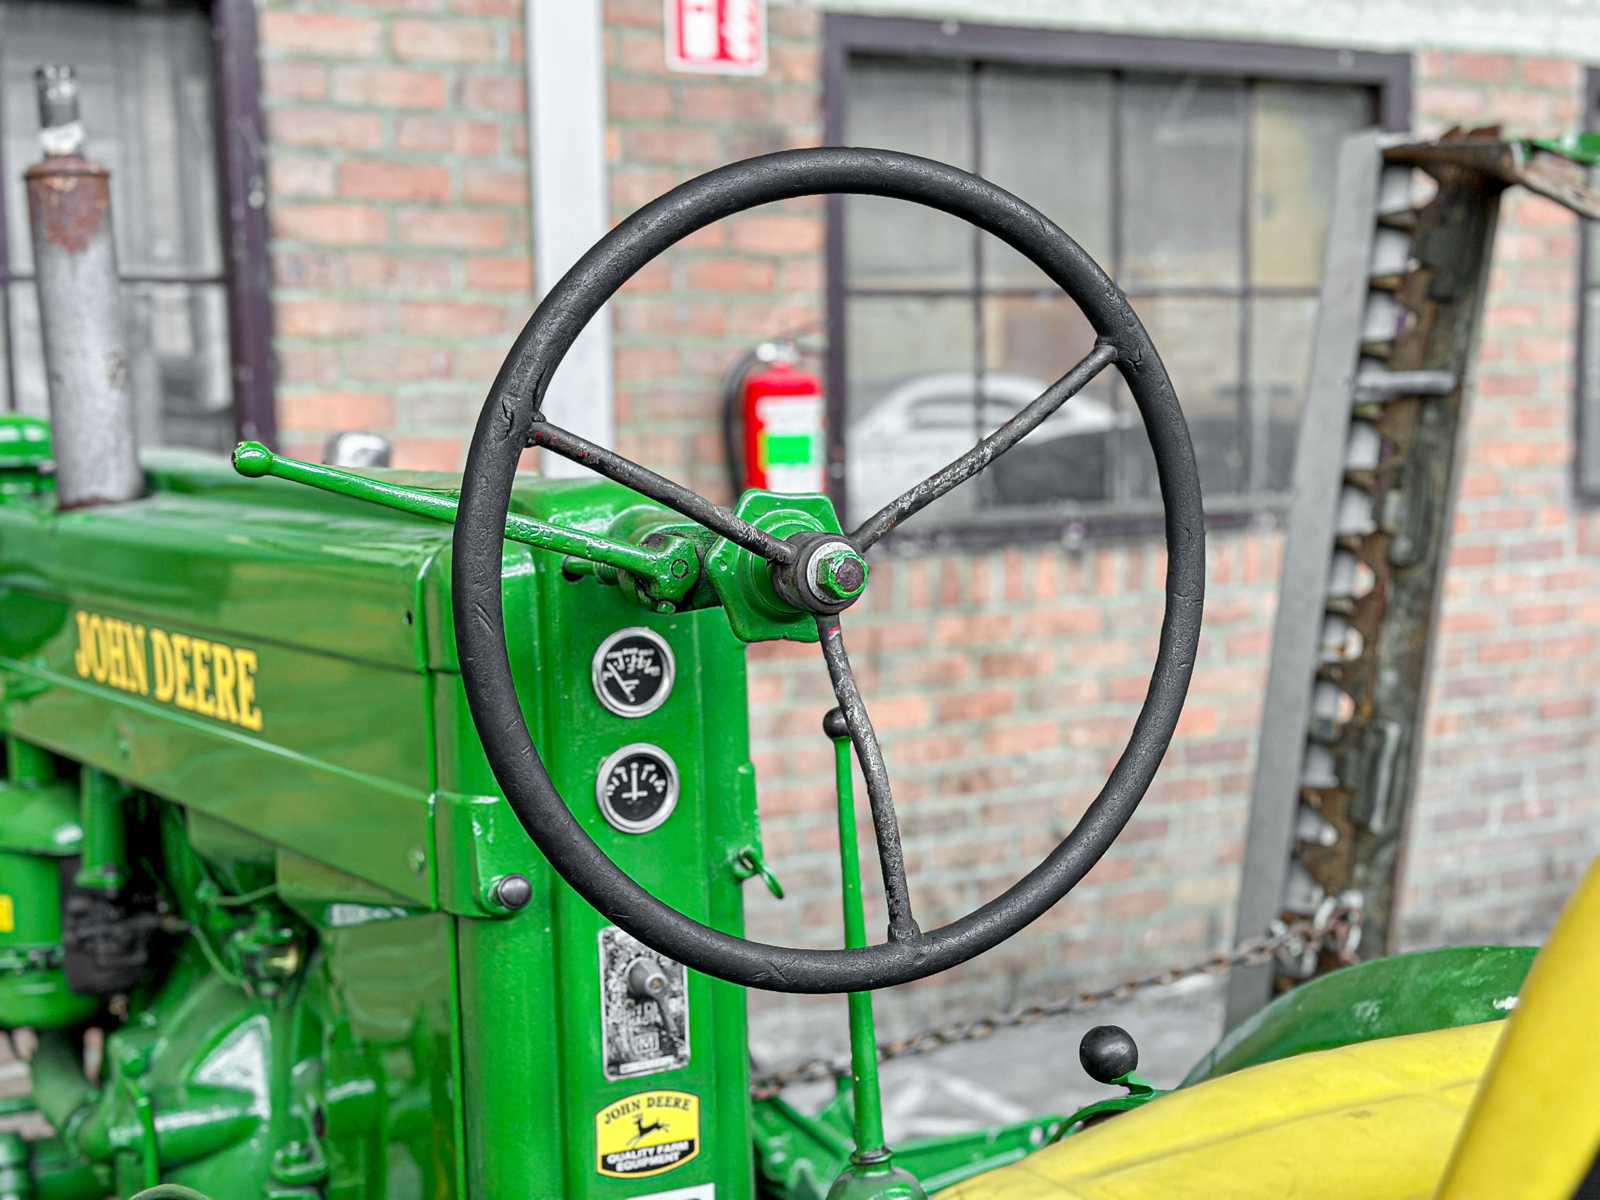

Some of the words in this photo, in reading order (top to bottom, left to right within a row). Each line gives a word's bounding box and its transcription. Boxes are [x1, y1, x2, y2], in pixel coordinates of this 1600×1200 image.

[75, 610, 149, 696] JOHN
[151, 628, 263, 731] DEERE
[604, 1100, 640, 1125] JOHN
[647, 1097, 691, 1111] DEERE
[606, 1147, 656, 1165] QUALITY
[656, 1141, 689, 1154] FARM
[615, 1153, 680, 1172] EQUIPMENT
